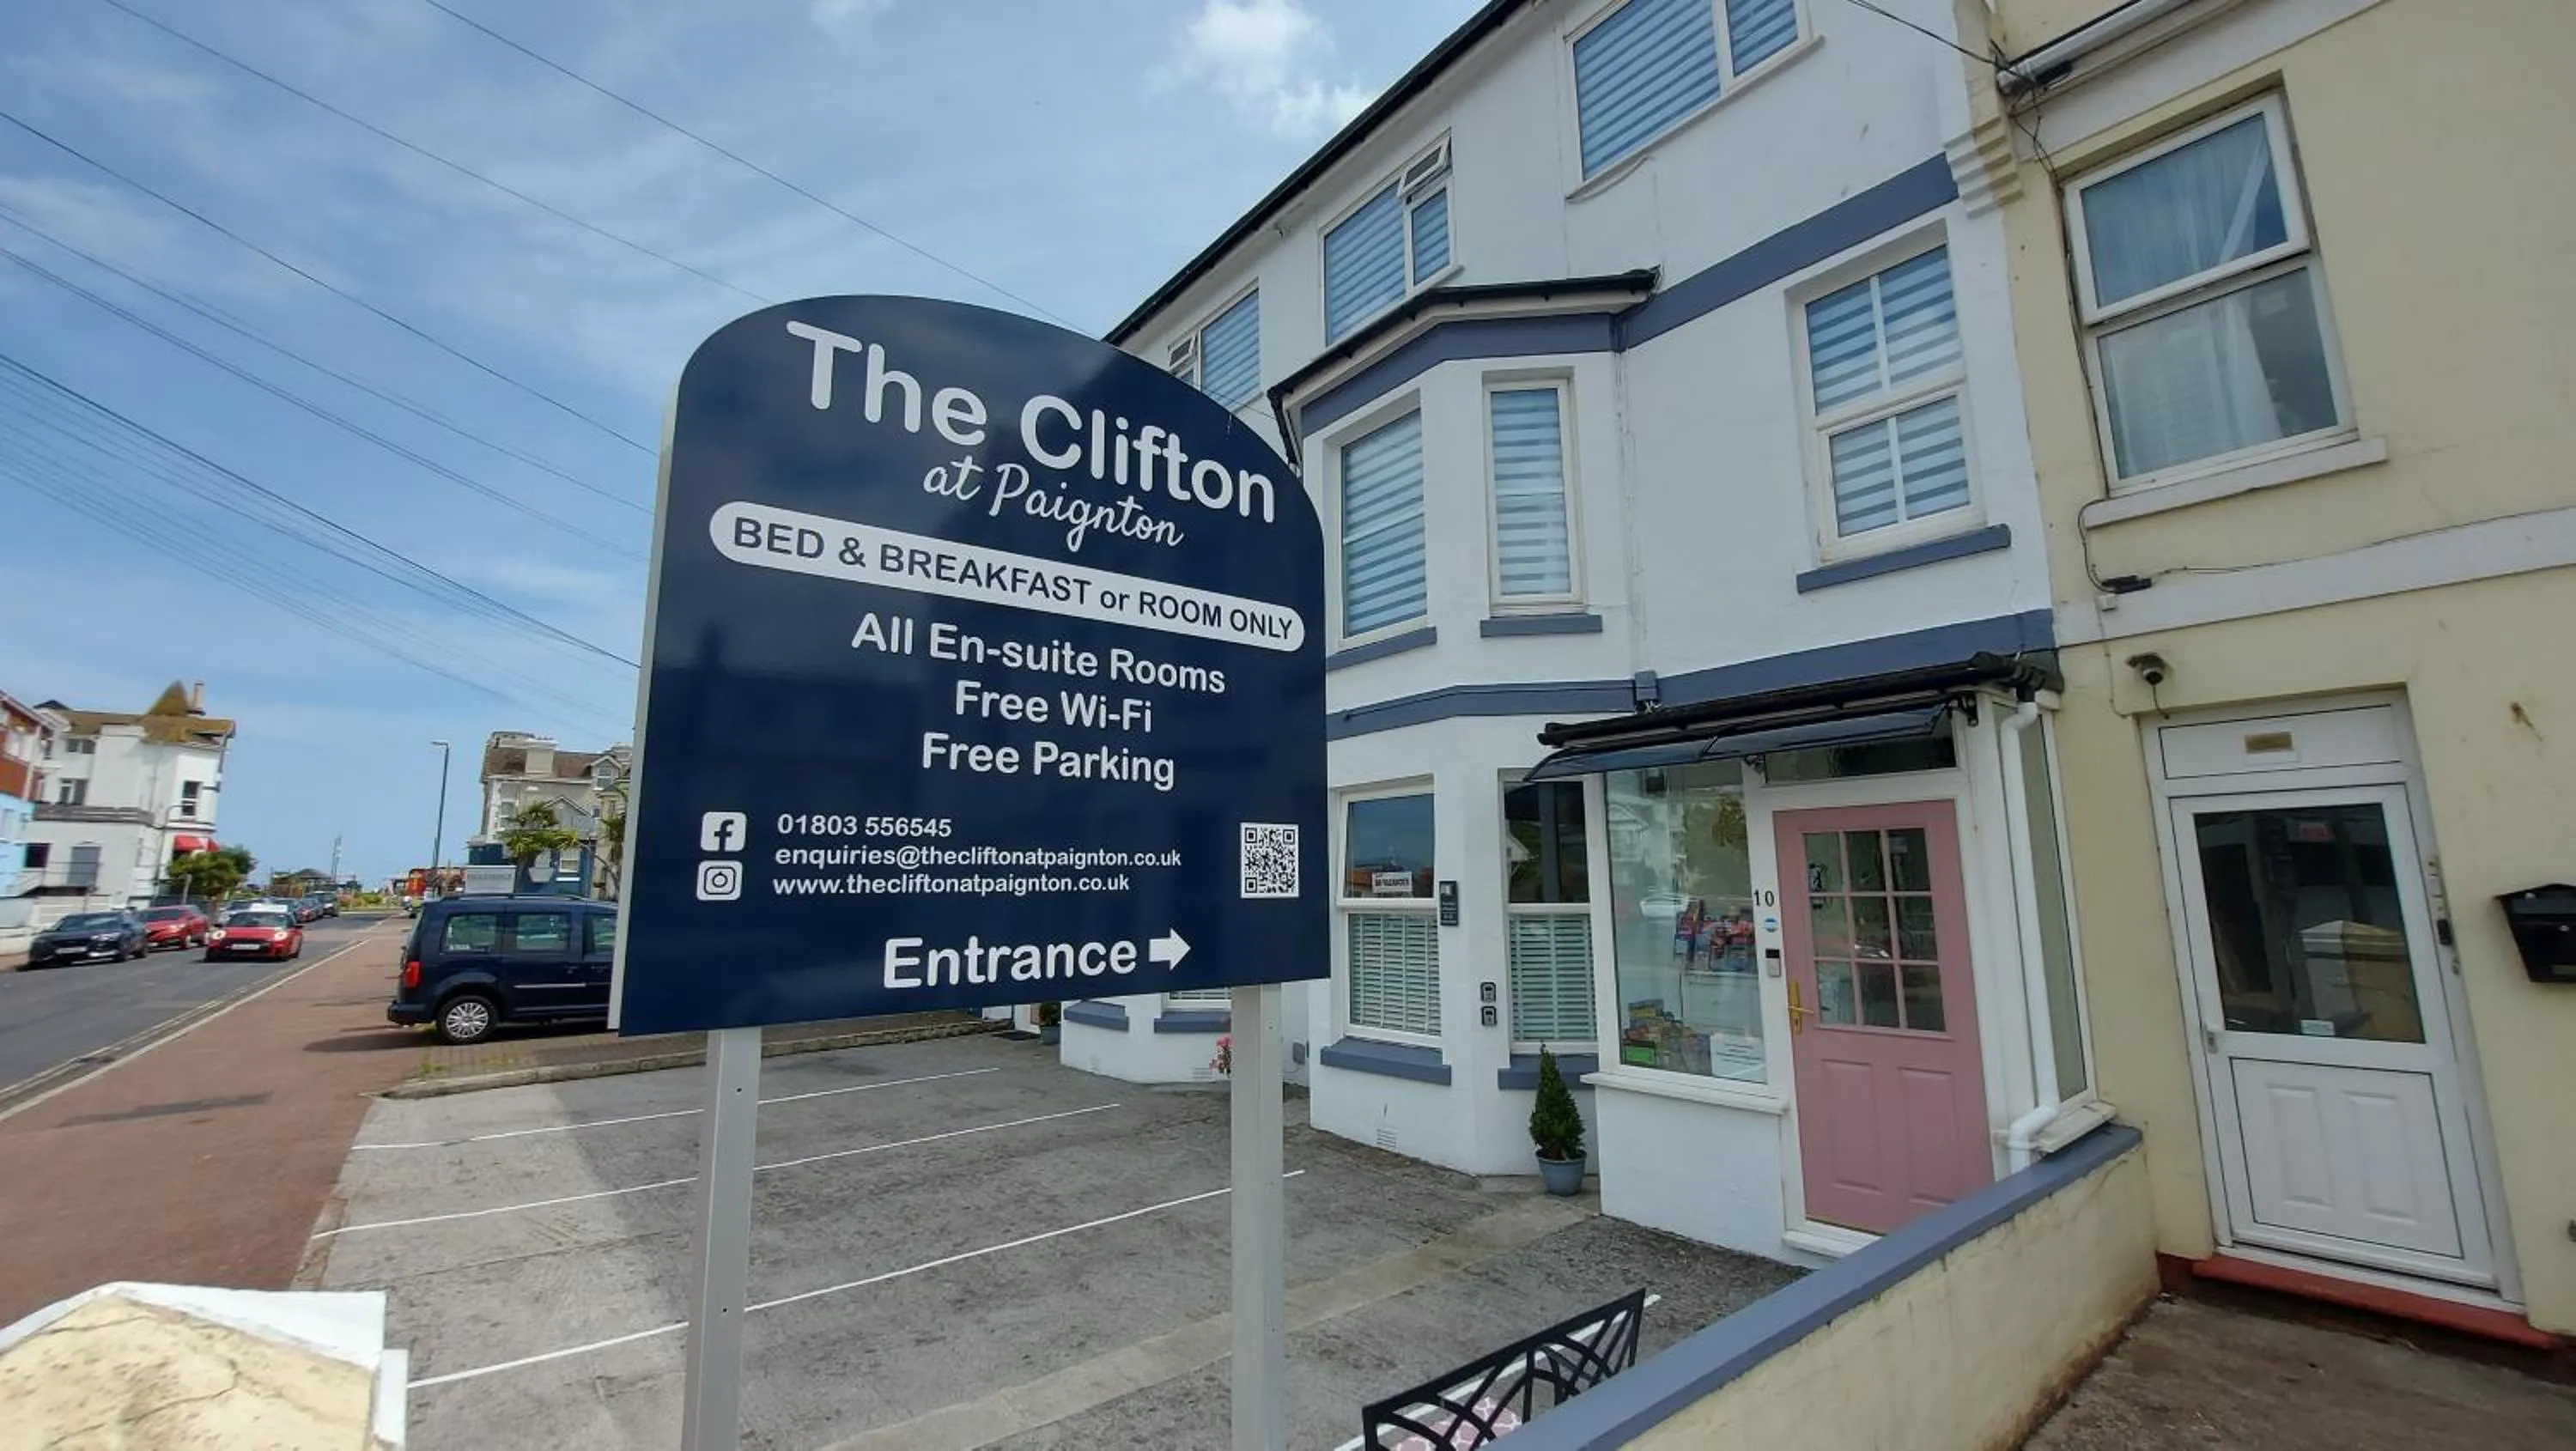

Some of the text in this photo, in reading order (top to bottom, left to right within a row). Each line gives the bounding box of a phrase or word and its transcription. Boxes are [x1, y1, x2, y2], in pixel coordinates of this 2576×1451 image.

[787, 321, 1273, 522] The Clifton
[924, 456, 1183, 551] at Paignton
[735, 517, 1291, 639] BED & BREAKFAST or ROOM ONLY
[852, 613, 1224, 692] All En-suite Rooms
[957, 680, 1151, 732] Free Wi-Fi
[923, 732, 1173, 791] Free Parking
[777, 814, 951, 836] 01803 556545
[775, 846, 1182, 870] enquiries@thecliftonatpaignton.co.uk
[773, 873, 1129, 896] www.thecliftonatpaignton.co.uk
[1753, 889, 1775, 907] 10
[884, 936, 1136, 987] Entrance
